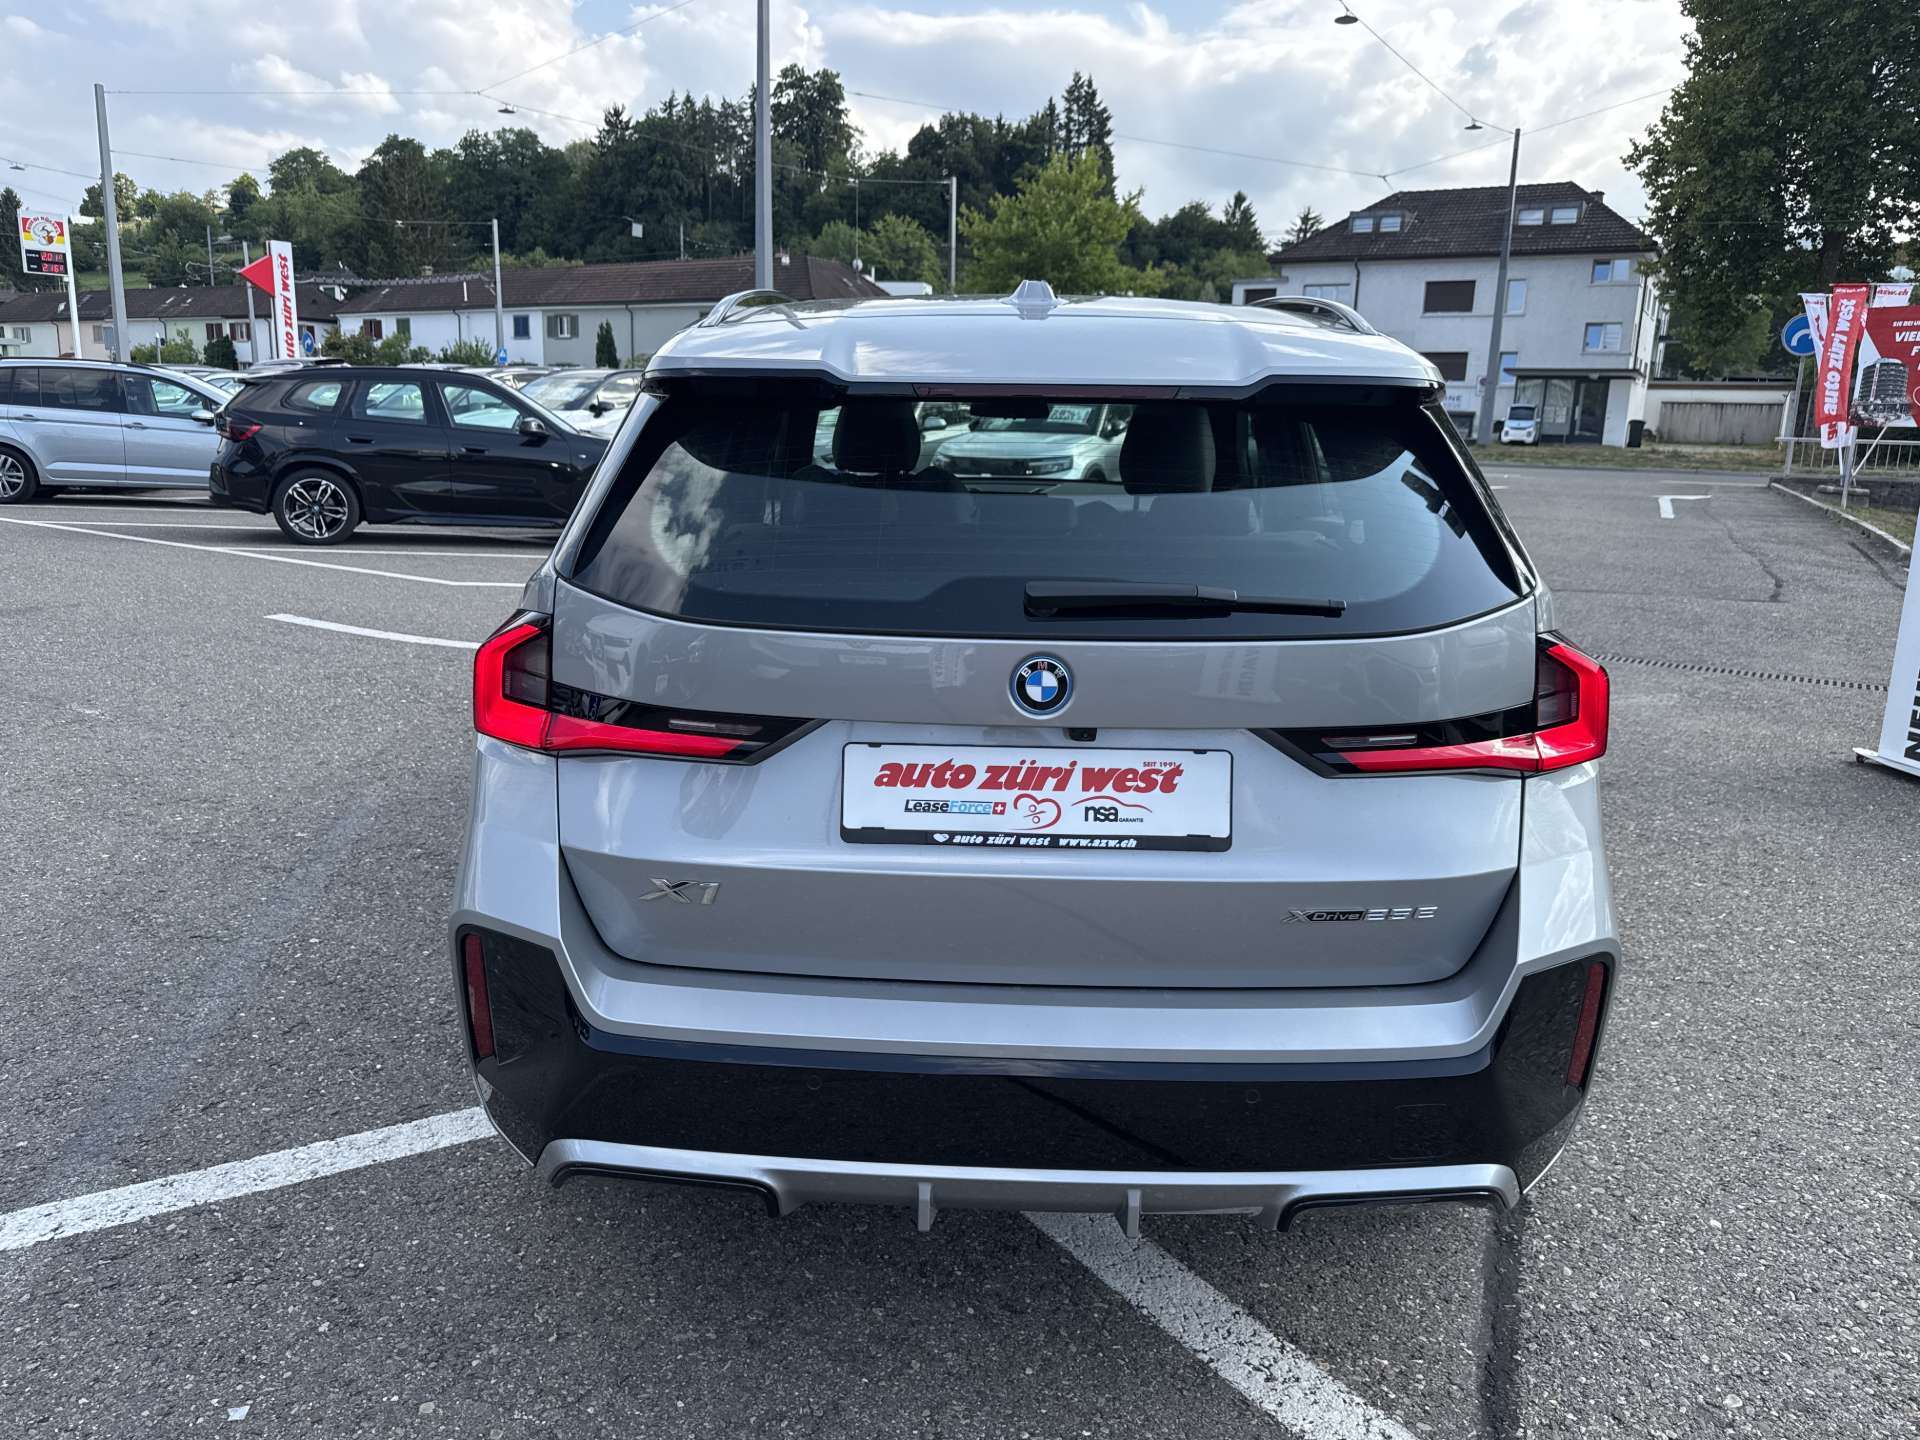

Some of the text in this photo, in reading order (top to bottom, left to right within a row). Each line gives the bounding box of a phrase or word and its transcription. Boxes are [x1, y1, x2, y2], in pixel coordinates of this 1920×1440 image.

[278, 253, 291, 293] west
[1835, 298, 1857, 332] west
[284, 331, 295, 358] uto
[1827, 331, 1848, 370] züri
[1823, 370, 1841, 416] auto
[1021, 661, 1065, 678] BMW
[873, 758, 1184, 794] auto züri west
[904, 799, 992, 814] LeaseForce
[1084, 806, 1119, 823] nsa
[952, 833, 1138, 848] auto züri west www.azw.ch
[639, 878, 720, 905] X1
